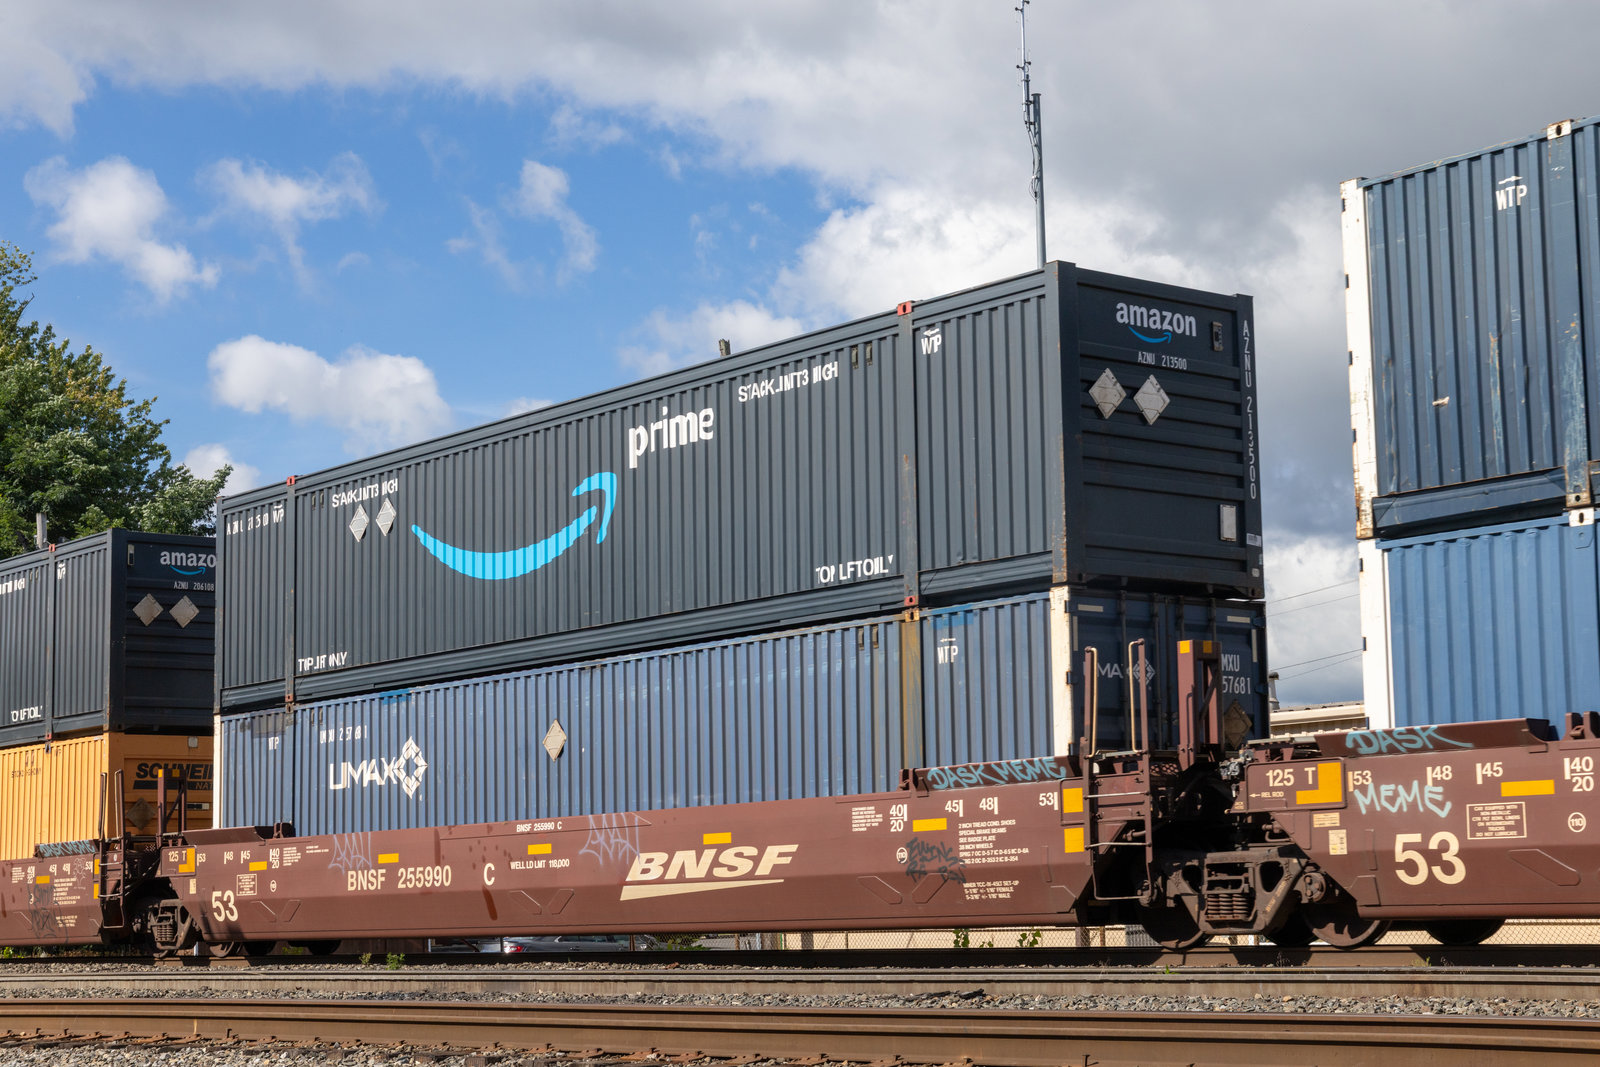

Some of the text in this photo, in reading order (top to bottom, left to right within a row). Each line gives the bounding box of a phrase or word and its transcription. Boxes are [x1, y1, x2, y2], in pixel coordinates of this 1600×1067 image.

[1496, 185, 1527, 210] WTP
[1116, 303, 1197, 336] amazon
[1138, 351, 1187, 370] AZNU 213500
[1243, 320, 1256, 499] AZNU 213500
[629, 406, 714, 468] prime
[174, 581, 214, 591] AZNU 206108
[938, 646, 958, 664] WTP
[1346, 726, 1474, 754] DASK
[1482, 762, 1503, 777] 45
[1571, 757, 1593, 772] 40
[330, 757, 398, 789] UMAX
[927, 757, 1067, 789] DASK MEME
[1266, 767, 1316, 786] 125 T
[1354, 770, 1372, 785] 53
[1432, 766, 1452, 780] 48
[1572, 776, 1594, 792] 20
[979, 798, 994, 810] 48
[1039, 793, 1053, 806] 53
[1354, 779, 1451, 818] MEME
[890, 804, 904, 816] 40
[945, 801, 959, 813] 45
[516, 821, 562, 832] BNSF 255990 C
[890, 820, 904, 832] 20
[168, 851, 186, 862] 125 T
[226, 851, 233, 860] 48
[243, 851, 250, 860] 45
[626, 844, 799, 881] BNSF
[1395, 831, 1466, 886] 53
[510, 861, 525, 869] WELL
[535, 860, 546, 868] LMT
[549, 859, 569, 869] 118,000
[348, 863, 495, 891] BNSF 255990 C
[212, 890, 238, 921] 53
